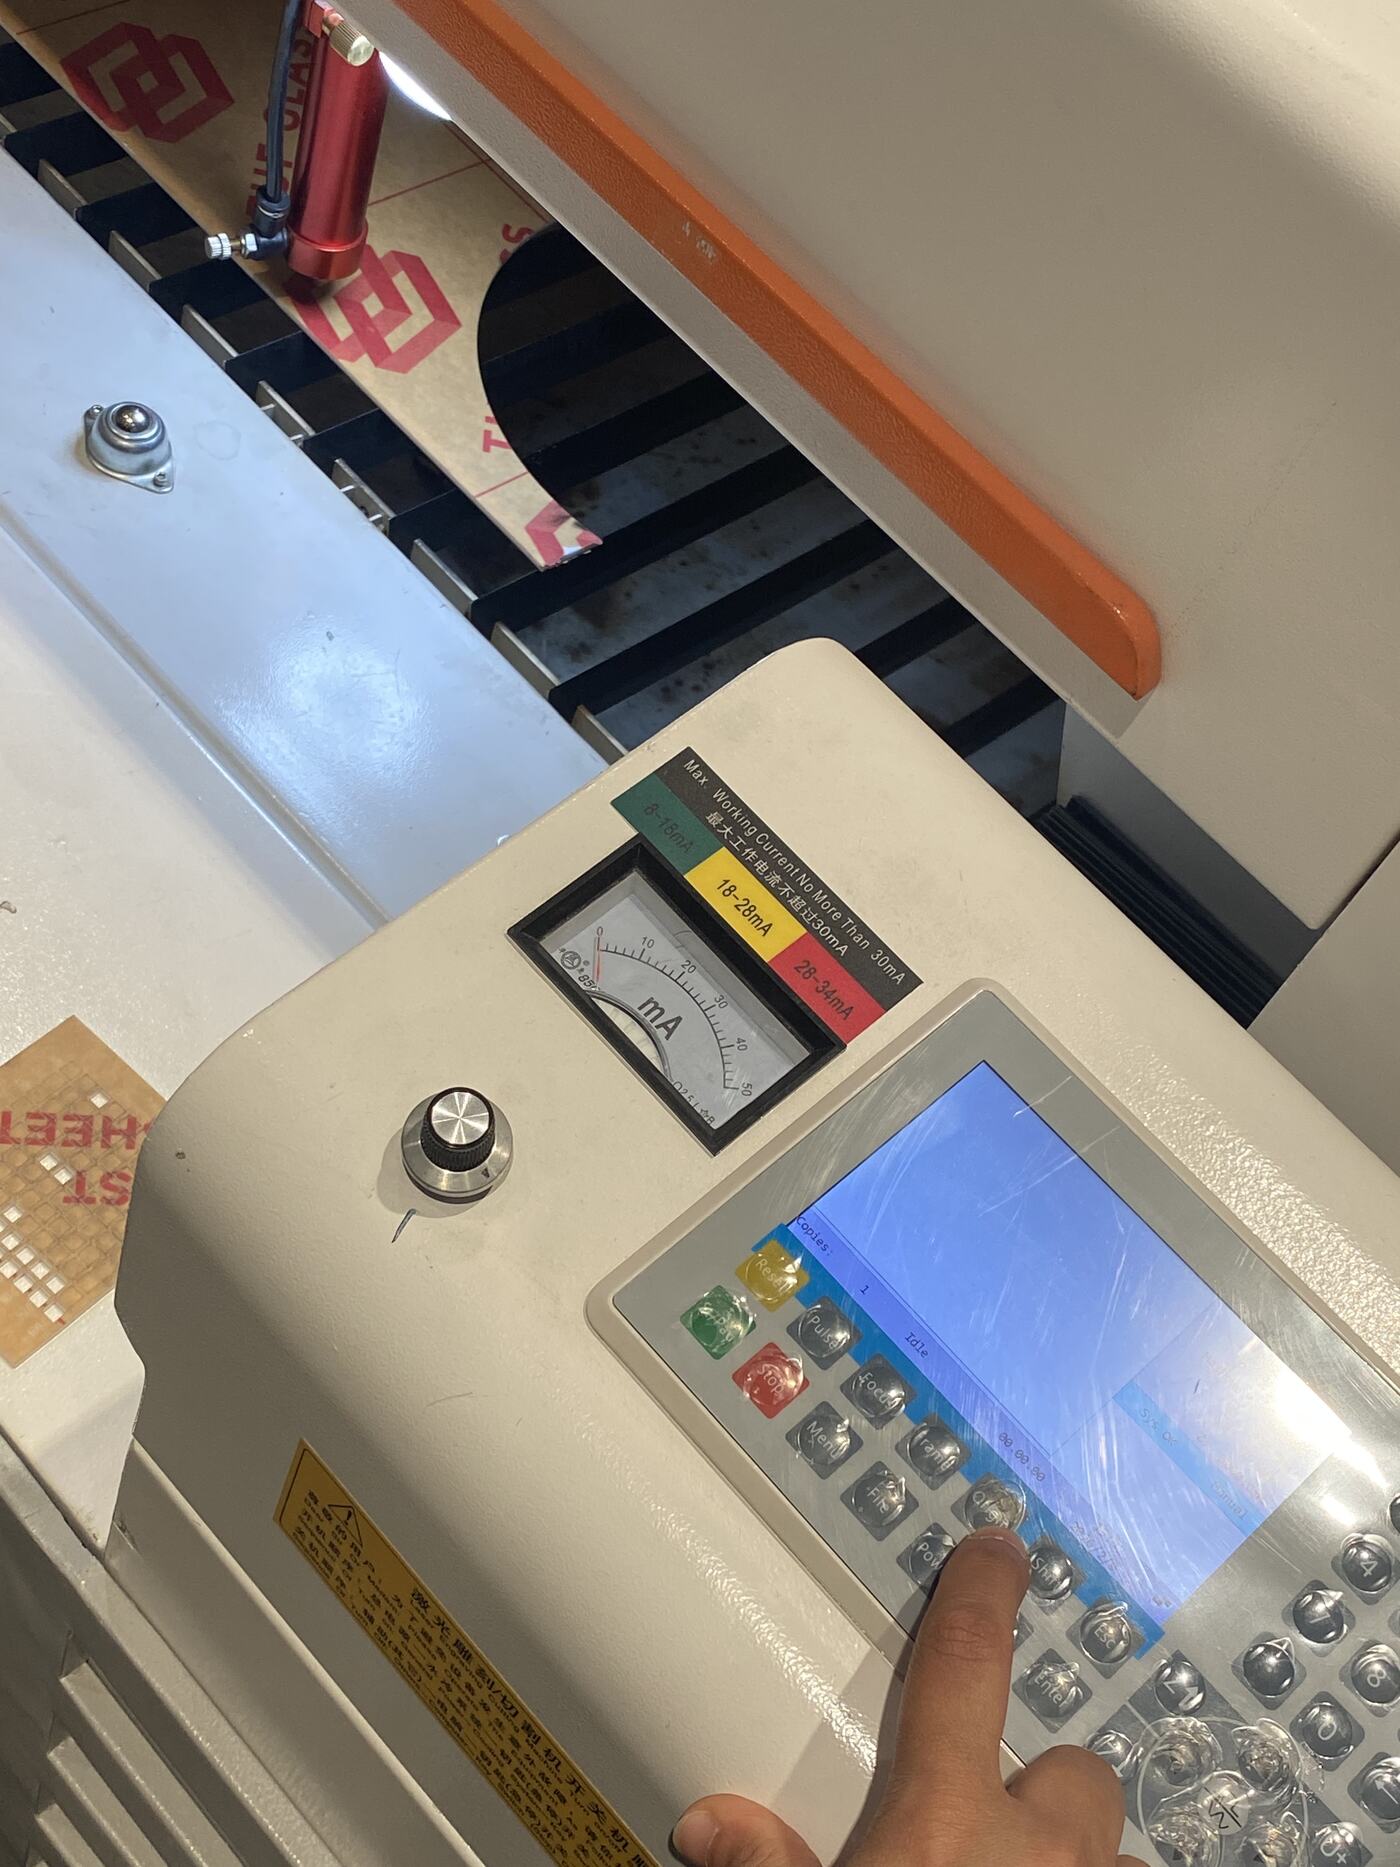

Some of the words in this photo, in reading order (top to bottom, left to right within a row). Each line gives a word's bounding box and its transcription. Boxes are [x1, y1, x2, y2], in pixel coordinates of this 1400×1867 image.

[644, 803, 693, 854] 8-18mA
[705, 811, 849, 957] 最大工作电流不超过30mA
[712, 787, 758, 837] Working
[755, 832, 801, 878] Current
[795, 872, 814, 894] No
[812, 889, 842, 921] More
[841, 917, 870, 950] Than
[870, 949, 906, 986] 30mA
[716, 879, 773, 937] 18-28mA
[641, 936, 655, 949] 10
[681, 960, 697, 974] 20
[714, 994, 729, 1009] 30
[793, 959, 855, 1021] 28-34mA
[637, 997, 684, 1041] mA
[736, 1037, 748, 1051] 40
[741, 1082, 753, 1097] 50
[0, 1110, 153, 1150] HEET
[796, 1216, 833, 1257] Copies:
[905, 1331, 929, 1359] Idle
[808, 1315, 840, 1351] Pulse
[757, 1362, 787, 1397] Stop
[807, 1420, 841, 1459] Menu
[916, 1541, 943, 1570] Pow
[1357, 1559, 1379, 1578] 4
[1094, 1623, 1117, 1649] Esc
[1367, 1667, 1386, 1688] 8
